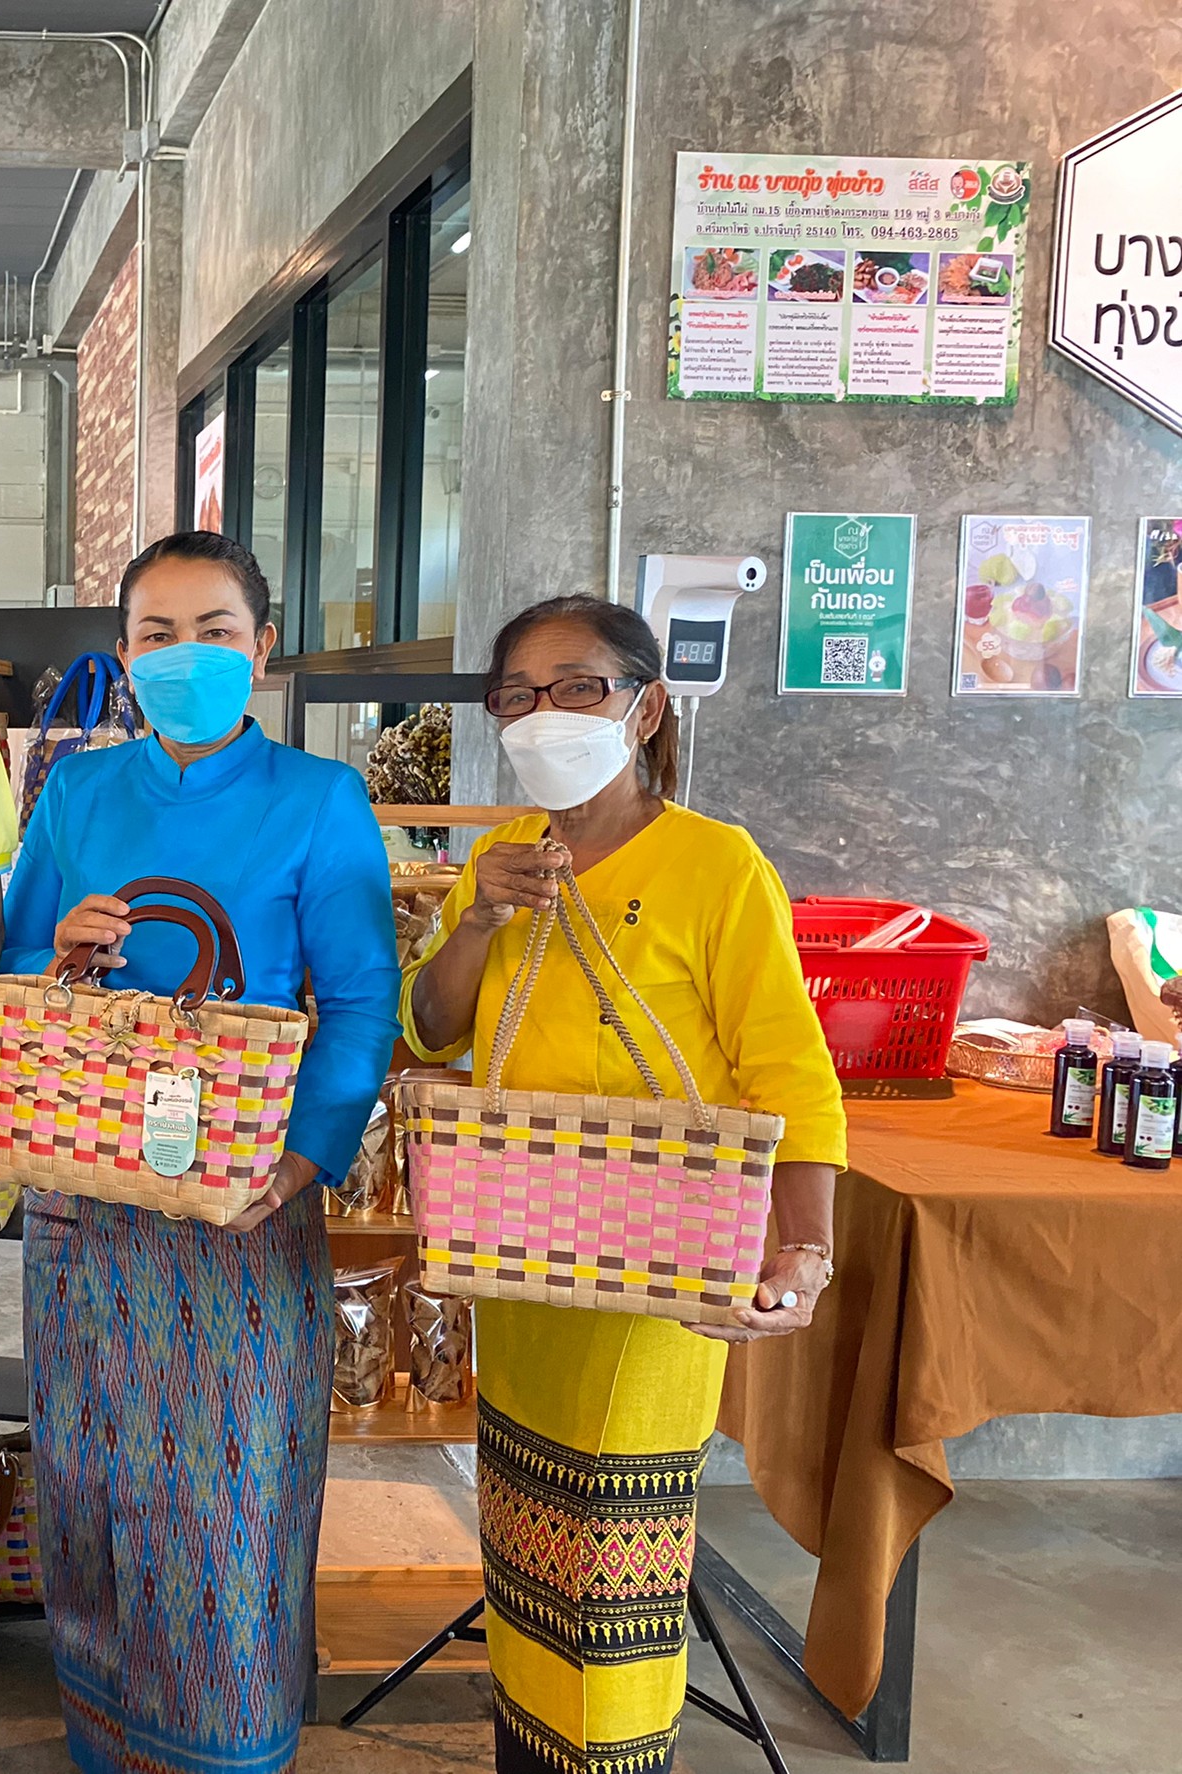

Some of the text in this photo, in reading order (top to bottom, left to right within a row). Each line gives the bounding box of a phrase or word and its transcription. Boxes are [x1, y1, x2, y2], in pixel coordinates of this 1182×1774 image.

[698, 165, 884, 199] ร้าน ณ บางกุ้ง ทุ่งข้าว
[894, 208, 912, 219] 119
[916, 206, 930, 223] หมู่
[934, 209, 941, 220] 3
[806, 226, 836, 237] 25140
[841, 221, 864, 237] โทร.
[871, 226, 958, 239] 094-463-2865
[804, 556, 894, 585] เป็นเพื่อน
[811, 587, 886, 610] กันเถอะ
